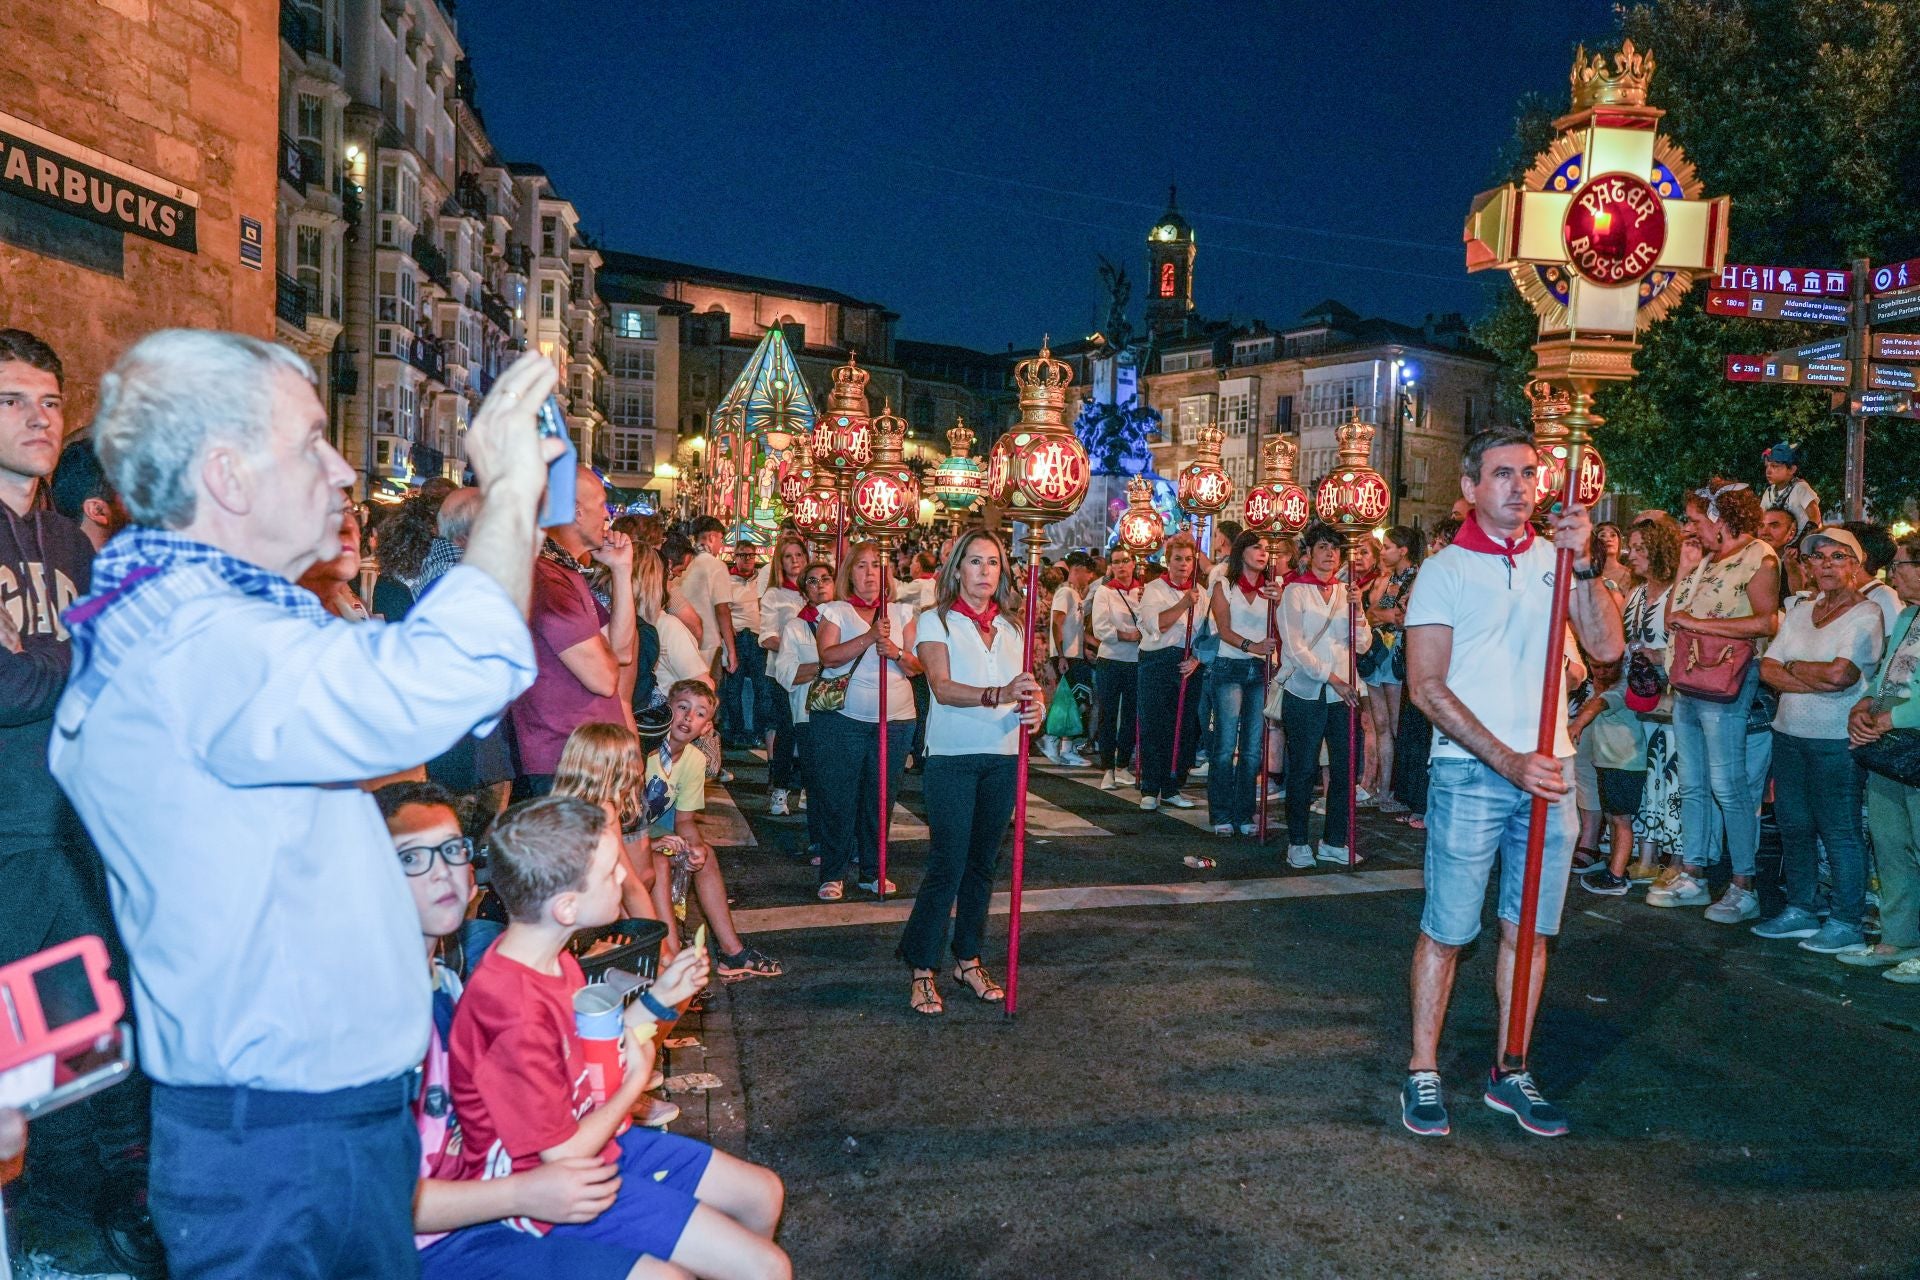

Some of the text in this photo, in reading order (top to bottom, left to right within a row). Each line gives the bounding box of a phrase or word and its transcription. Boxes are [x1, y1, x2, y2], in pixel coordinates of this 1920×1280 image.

[0, 141, 177, 237] ARBUCKS
[1578, 178, 1655, 229] PATER
[1726, 299, 1737, 307] 180
[1784, 300, 1822, 309] Aldundiaren
[1780, 309, 1802, 317] Palacio
[1818, 313, 1846, 321] Provincia
[1877, 310, 1898, 319] Parada
[1894, 338, 1912, 346] Pedro
[1881, 348, 1902, 356] Iglesia
[1808, 363, 1829, 371] Katedral
[1875, 367, 1893, 376] Turismo
[1874, 377, 1891, 385] Oficina
[1898, 380, 1916, 388] Turismo
